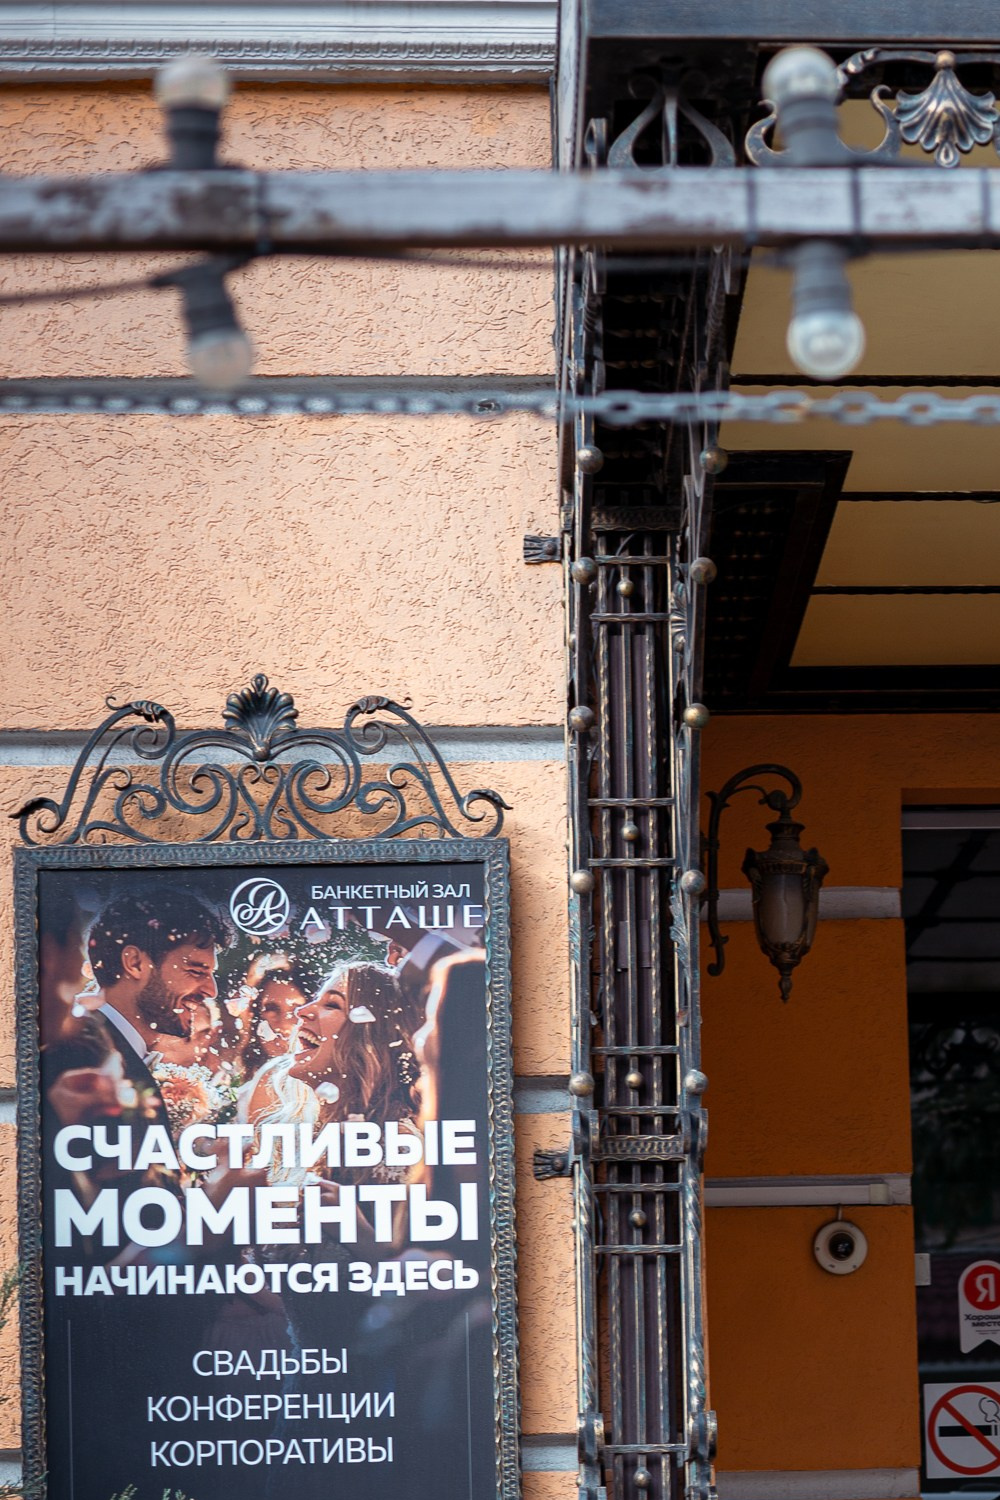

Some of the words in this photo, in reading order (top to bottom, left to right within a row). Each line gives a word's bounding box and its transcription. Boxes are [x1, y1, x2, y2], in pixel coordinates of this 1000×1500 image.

[311, 881, 428, 900] БАНКЕТНЫЙ
[432, 883, 471, 899] ЗАЛ
[300, 904, 484, 930] АТТАШЕ
[53, 1119, 477, 1172] СЧАСТЛИВЫЕ
[54, 1182, 479, 1248] МОМЕНТЫ
[56, 1263, 339, 1297] НАЧИНАЮТСЯ
[349, 1259, 480, 1298] ЗДЕСЬ
[975, 1273, 996, 1303] Я
[192, 1348, 348, 1381] СВАДЬБЫ
[146, 1391, 396, 1424] КОНФЕРЕНЦИИ
[150, 1436, 394, 1467] КОРПОРАТИВЫ
